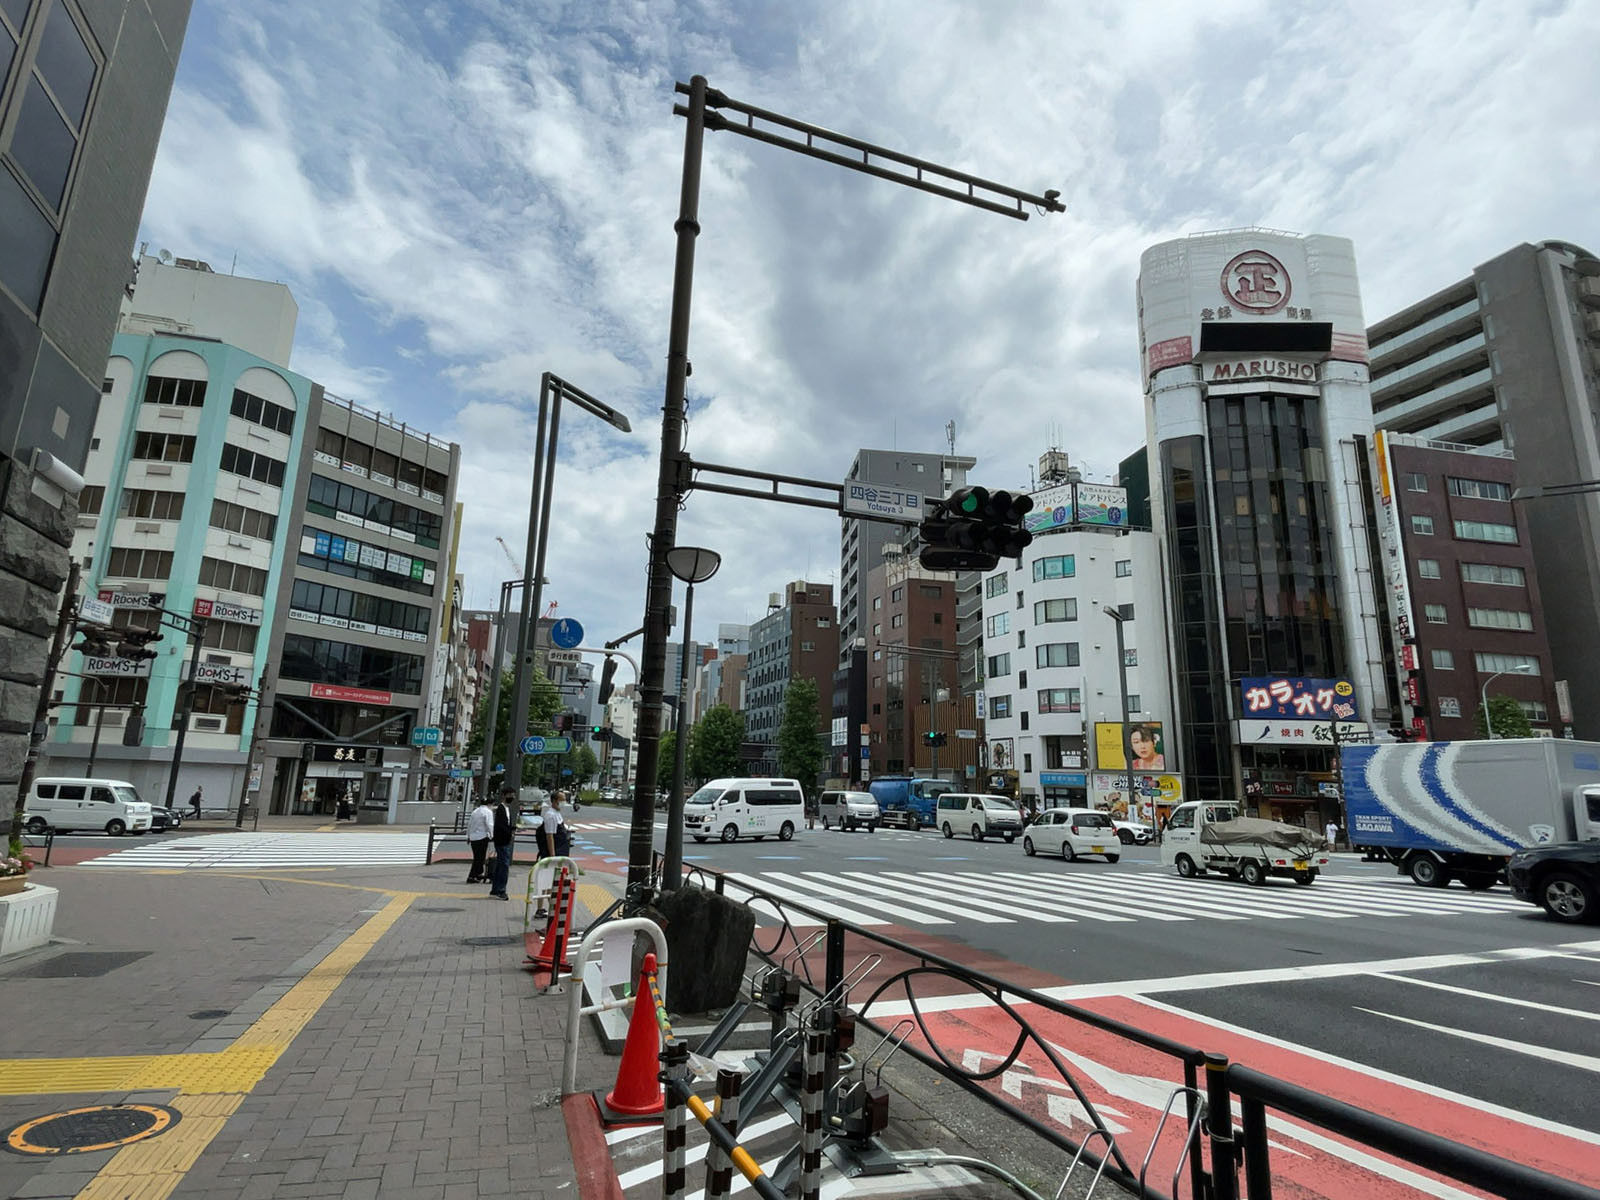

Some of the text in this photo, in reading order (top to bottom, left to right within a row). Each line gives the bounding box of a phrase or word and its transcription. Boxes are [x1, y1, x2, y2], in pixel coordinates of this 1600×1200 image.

[1234, 262, 1283, 304] 正
[1213, 361, 1314, 379] MARUSHO
[851, 486, 918, 508] 四谷三丁目
[867, 502, 904, 514] Yotsuya 3
[113, 595, 149, 607] ROOM'S
[1337, 684, 1350, 693] 3F
[1246, 680, 1334, 715] カラオケ
[1281, 728, 1304, 738] 焼肉
[528, 740, 543, 750] 319
[334, 748, 355, 761] 蕎麦
[1355, 823, 1394, 833] SAGAWA
